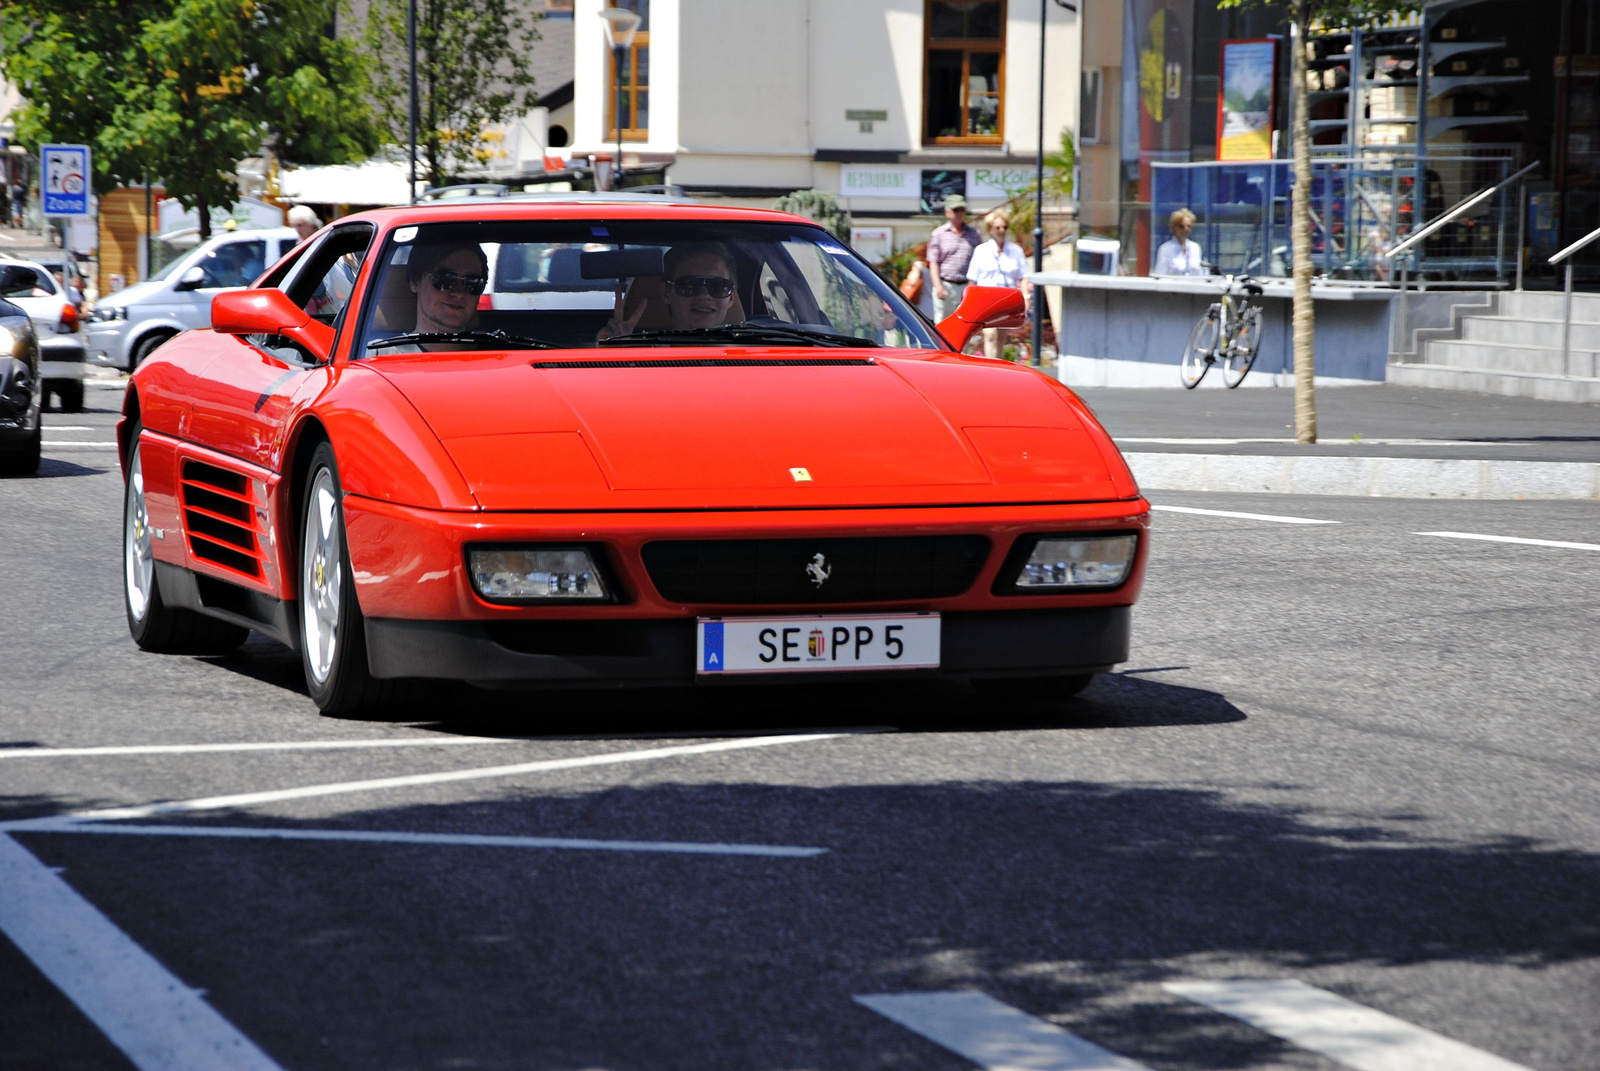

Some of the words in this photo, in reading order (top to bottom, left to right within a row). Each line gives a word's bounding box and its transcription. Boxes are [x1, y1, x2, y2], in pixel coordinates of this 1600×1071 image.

[47, 196, 84, 211] Zone
[758, 628, 801, 663] SE
[832, 625, 874, 661] PP
[885, 625, 904, 660] 5
[708, 652, 719, 665] A
